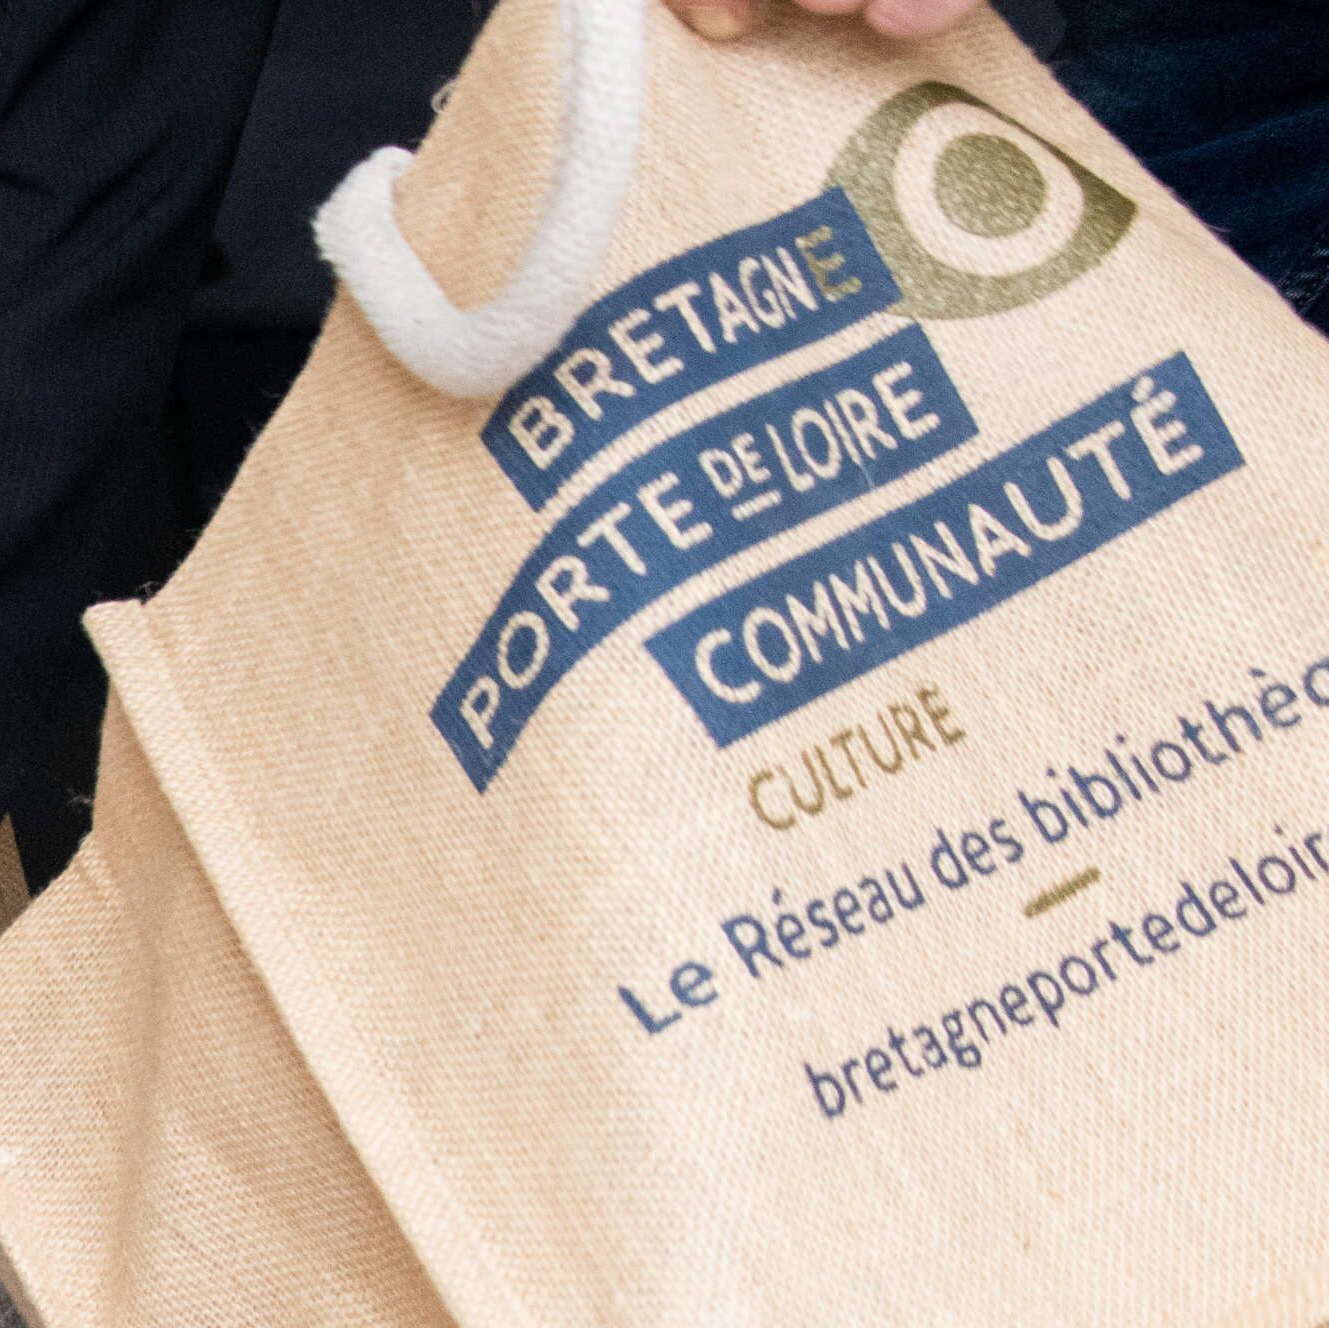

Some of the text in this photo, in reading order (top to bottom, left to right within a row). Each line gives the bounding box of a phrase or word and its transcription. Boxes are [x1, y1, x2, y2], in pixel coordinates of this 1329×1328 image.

[506, 225, 861, 473] BRETAGNE
[459, 361, 940, 750] PORTE DE LOIRE
[694, 375, 1205, 704] COMMUNAUTÉ
[747, 686, 967, 832] CULTURE
[617, 959, 718, 1036] Le
[721, 861, 925, 978] Réseau
[931, 818, 1024, 893] des
